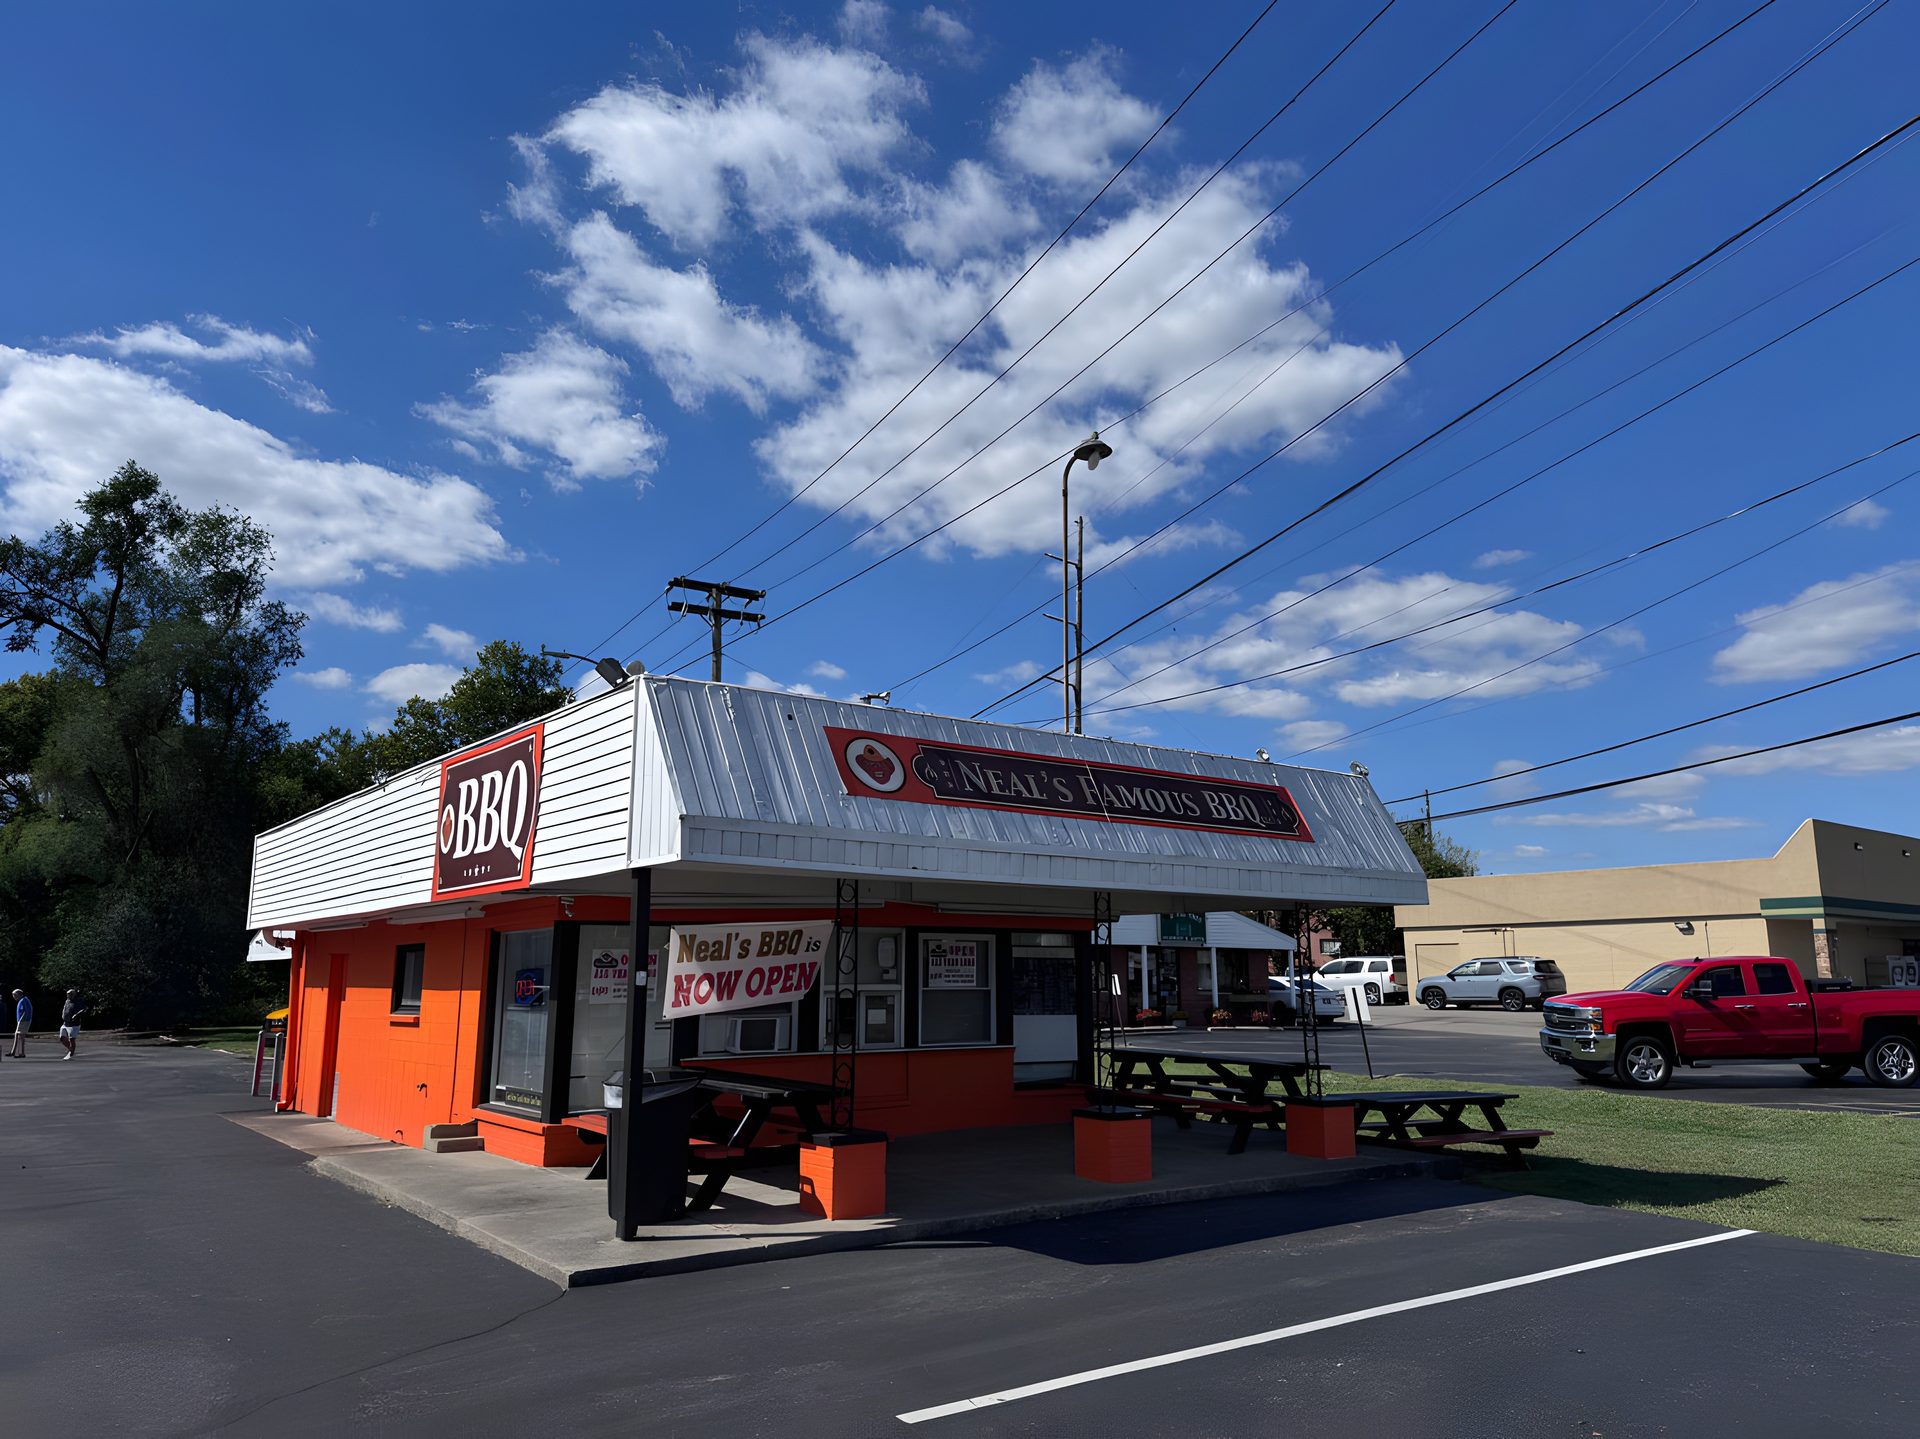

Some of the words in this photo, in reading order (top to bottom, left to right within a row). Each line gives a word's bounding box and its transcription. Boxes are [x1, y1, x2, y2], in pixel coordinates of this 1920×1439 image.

[453, 760, 528, 863] BBQ
[954, 759, 1074, 803] NEAL'S
[1076, 774, 1200, 817] FAMOUS
[1201, 790, 1267, 828] BBQ
[677, 932, 752, 964] Neal's
[756, 929, 804, 958] BBQ
[804, 936, 822, 953] is
[672, 969, 744, 1009] NOW
[745, 961, 818, 998] OPEN
